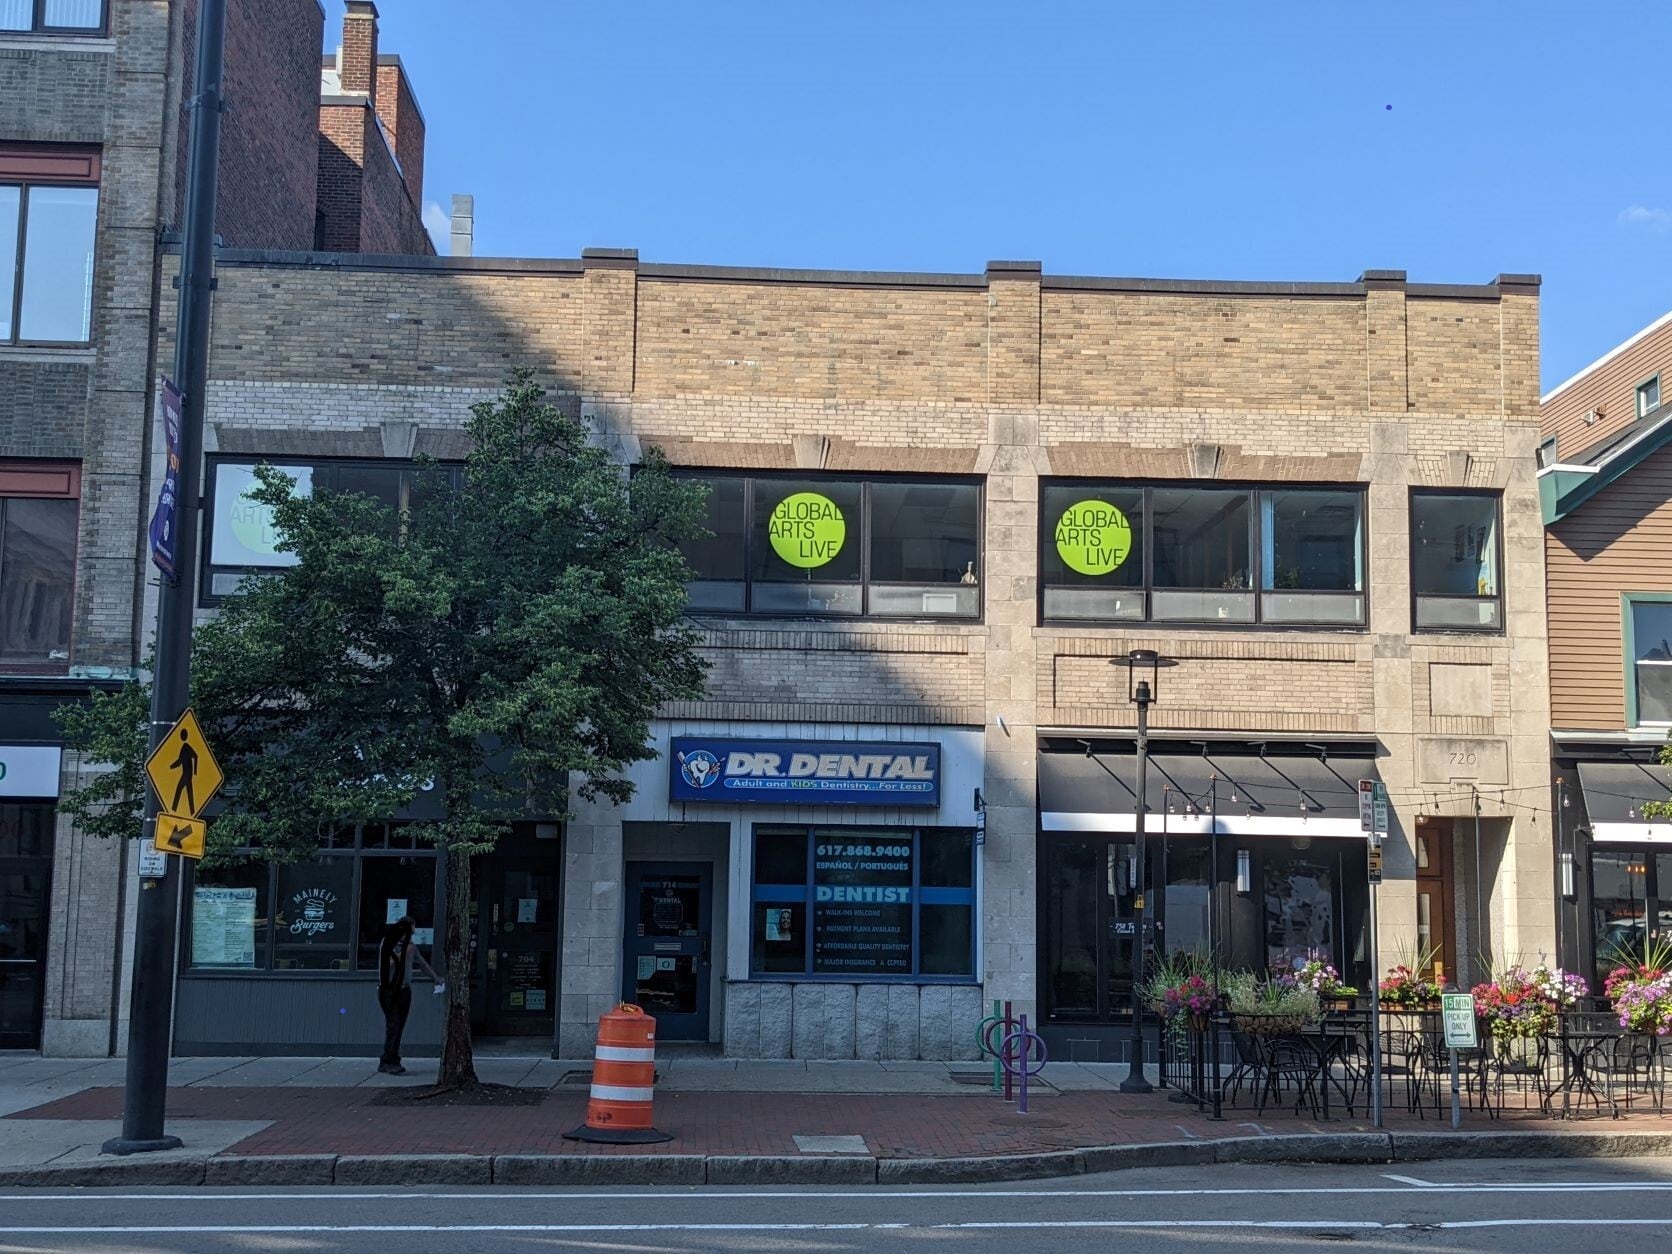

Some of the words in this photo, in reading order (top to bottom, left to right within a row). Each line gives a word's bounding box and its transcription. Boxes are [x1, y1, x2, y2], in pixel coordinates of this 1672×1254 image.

[774, 502, 845, 521] GLOBAL
[1060, 509, 1131, 529] GLOBAL
[769, 520, 815, 540] ARTS
[1056, 528, 1102, 547] ARTS
[799, 540, 838, 559] LIVE
[1086, 548, 1124, 566] LIVE
[1449, 752, 1477, 765] 720
[787, 753, 935, 780] DENTAL
[732, 779, 762, 787] Adult
[766, 779, 787, 788] and
[900, 782, 926, 790] Less!
[816, 844, 910, 857] 617.868.9400
[816, 860, 853, 870] ESPAÑOL
[292, 888, 338, 904] MAINELY
[816, 886, 910, 903] DENTIST
[853, 909, 880, 917] WELCOME
[290, 918, 335, 936] Burgers
[823, 942, 857, 950] AFFORDABLE
[881, 943, 910, 951] DENTISTRY
[518, 955, 535, 963] 704
[1444, 998, 1454, 1009] 15
[1454, 997, 1470, 1009] MIN
[1447, 1012, 1461, 1021] PICK
[1461, 1012, 1470, 1020] UP
[1451, 1022, 1467, 1031] ONLY
